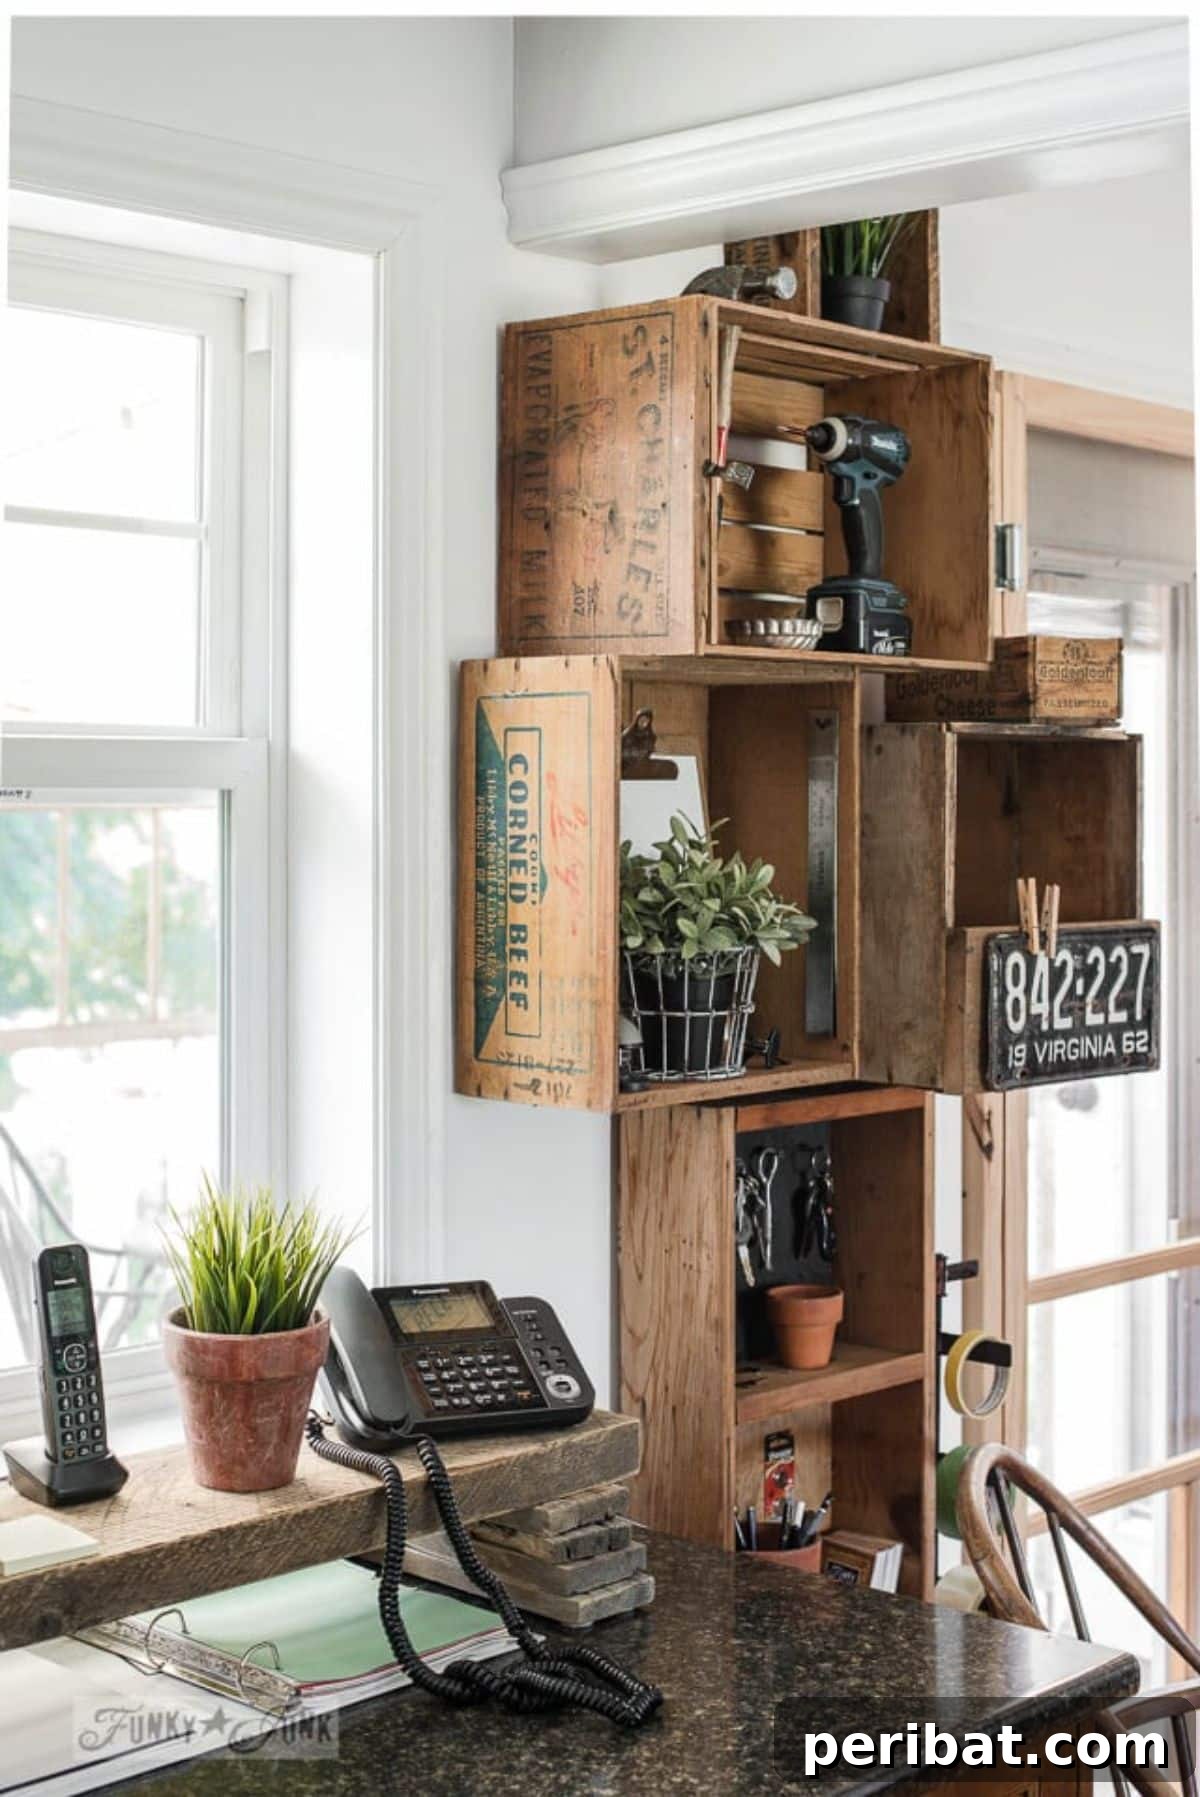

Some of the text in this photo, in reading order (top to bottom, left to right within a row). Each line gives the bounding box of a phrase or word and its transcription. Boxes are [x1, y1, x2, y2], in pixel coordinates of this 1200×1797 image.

[621, 324, 656, 396] ST.
[520, 549, 547, 634] MILK
[508, 753, 529, 1011] CORNED BEEF
[1008, 1029, 1149, 1069] 19 VIRGINIA 62
